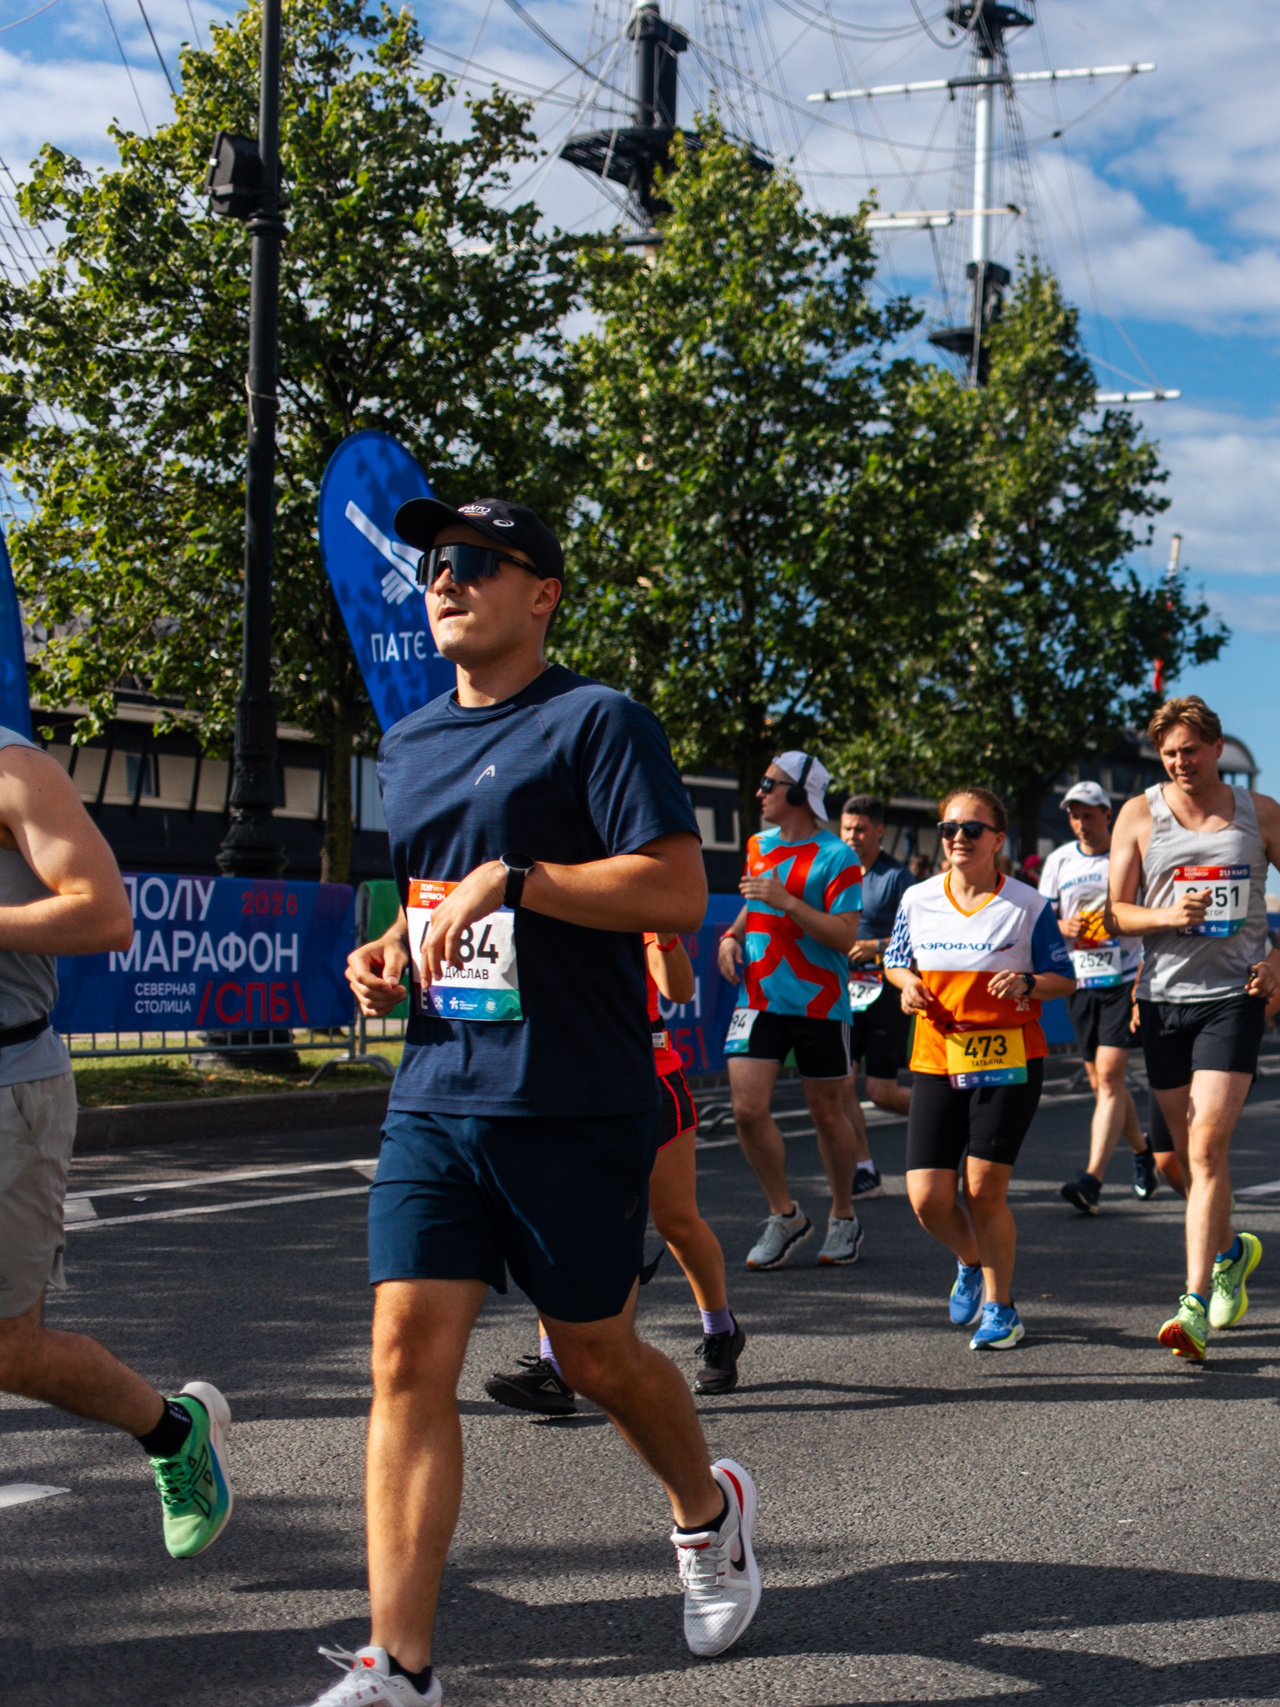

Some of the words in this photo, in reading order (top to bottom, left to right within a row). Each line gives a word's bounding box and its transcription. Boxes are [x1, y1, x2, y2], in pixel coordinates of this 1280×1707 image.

[242, 892, 298, 915] 2026
[109, 930, 298, 972] МАРАФОН
[1079, 952, 1113, 968] 2527
[135, 982, 196, 996] СЕВЕРНАЯ
[135, 999, 192, 1014] СТОЛИЦА
[964, 1035, 1007, 1058] 473
[971, 1059, 1004, 1067] ТАТЬЯНА
